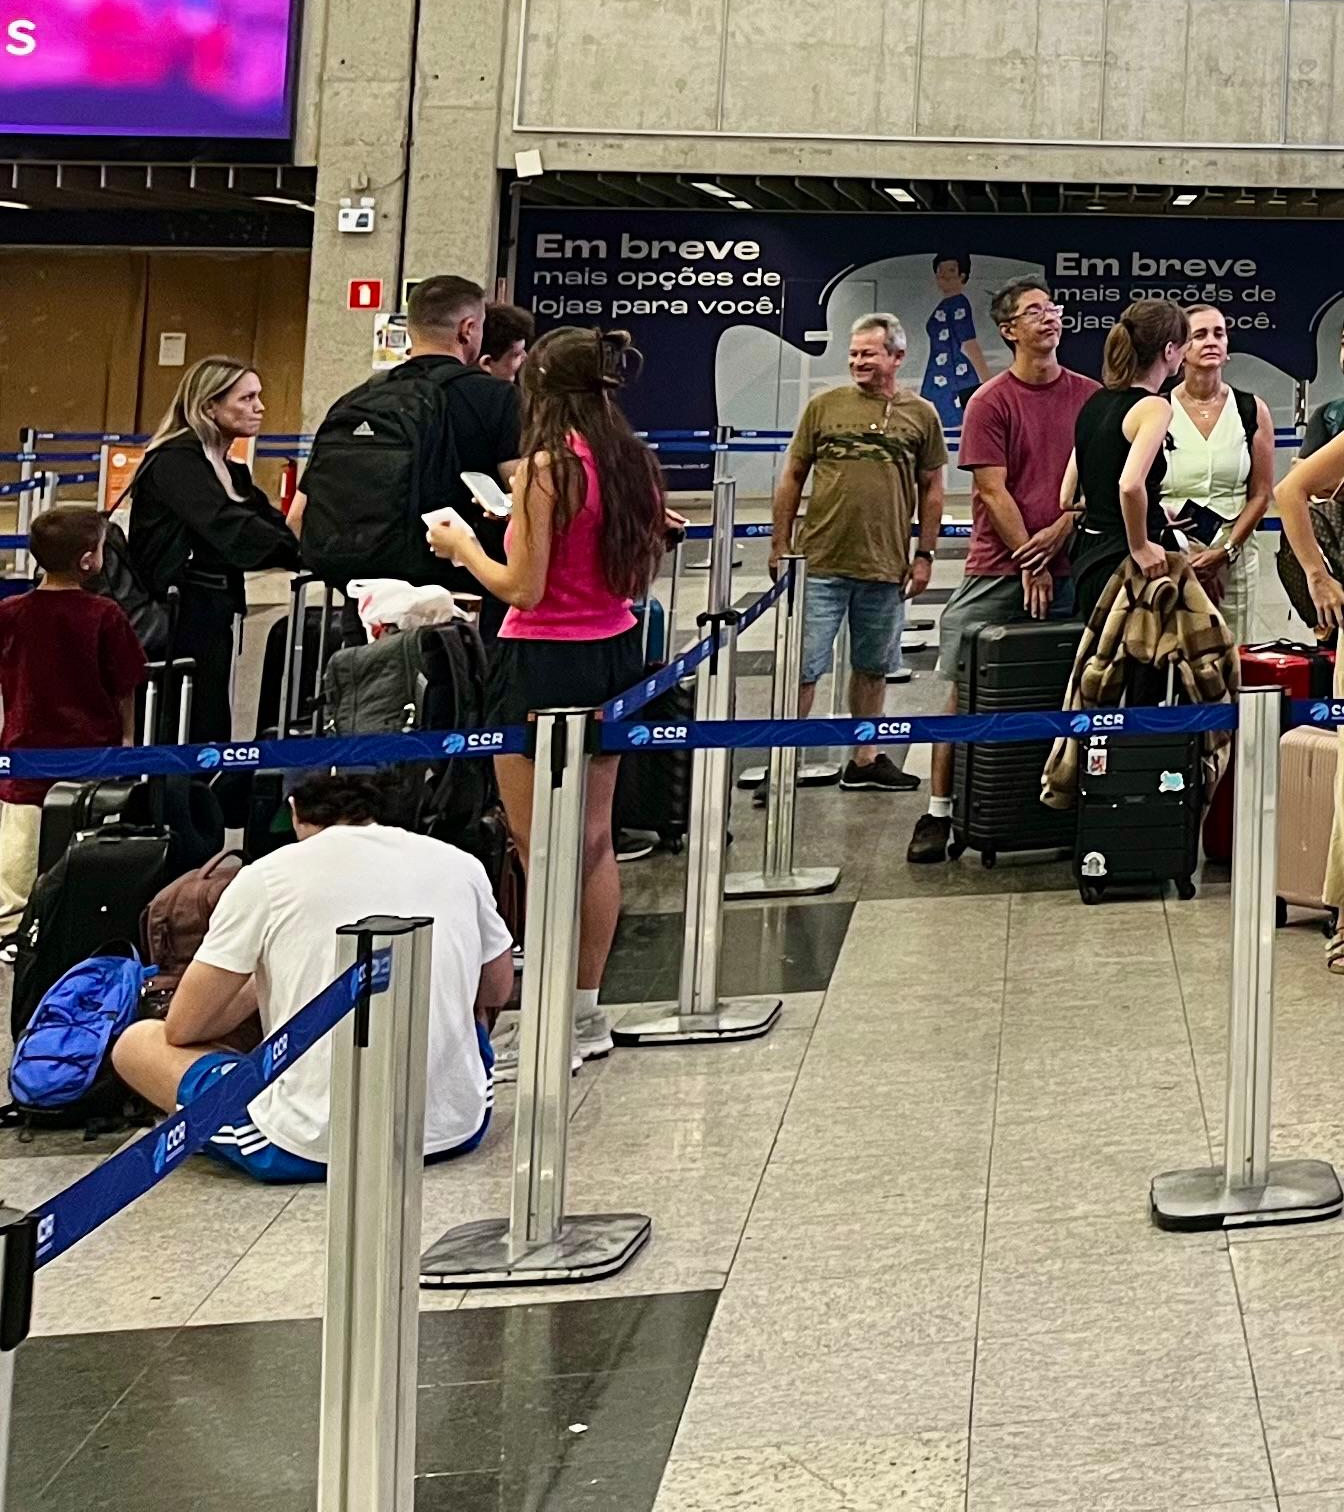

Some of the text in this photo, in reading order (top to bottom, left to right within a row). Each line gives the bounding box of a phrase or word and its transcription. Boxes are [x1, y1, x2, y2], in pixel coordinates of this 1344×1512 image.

[5, 19, 38, 57] S
[535, 233, 761, 261] Em breve
[1055, 251, 1257, 277] Em breve
[533, 265, 781, 291] mais opções de
[1053, 284, 1120, 302] mais
[1241, 284, 1276, 303] de
[532, 294, 781, 319] lojas para você.
[1061, 311, 1277, 334] ojas ocê.
[877, 722, 912, 735] CCR
[1092, 713, 1125, 726] CCR
[467, 732, 504, 746] CCR
[652, 726, 688, 739] CCR
[222, 746, 260, 761] CCR
[272, 1033, 289, 1061] CCR
[166, 1120, 186, 1150] CCR
